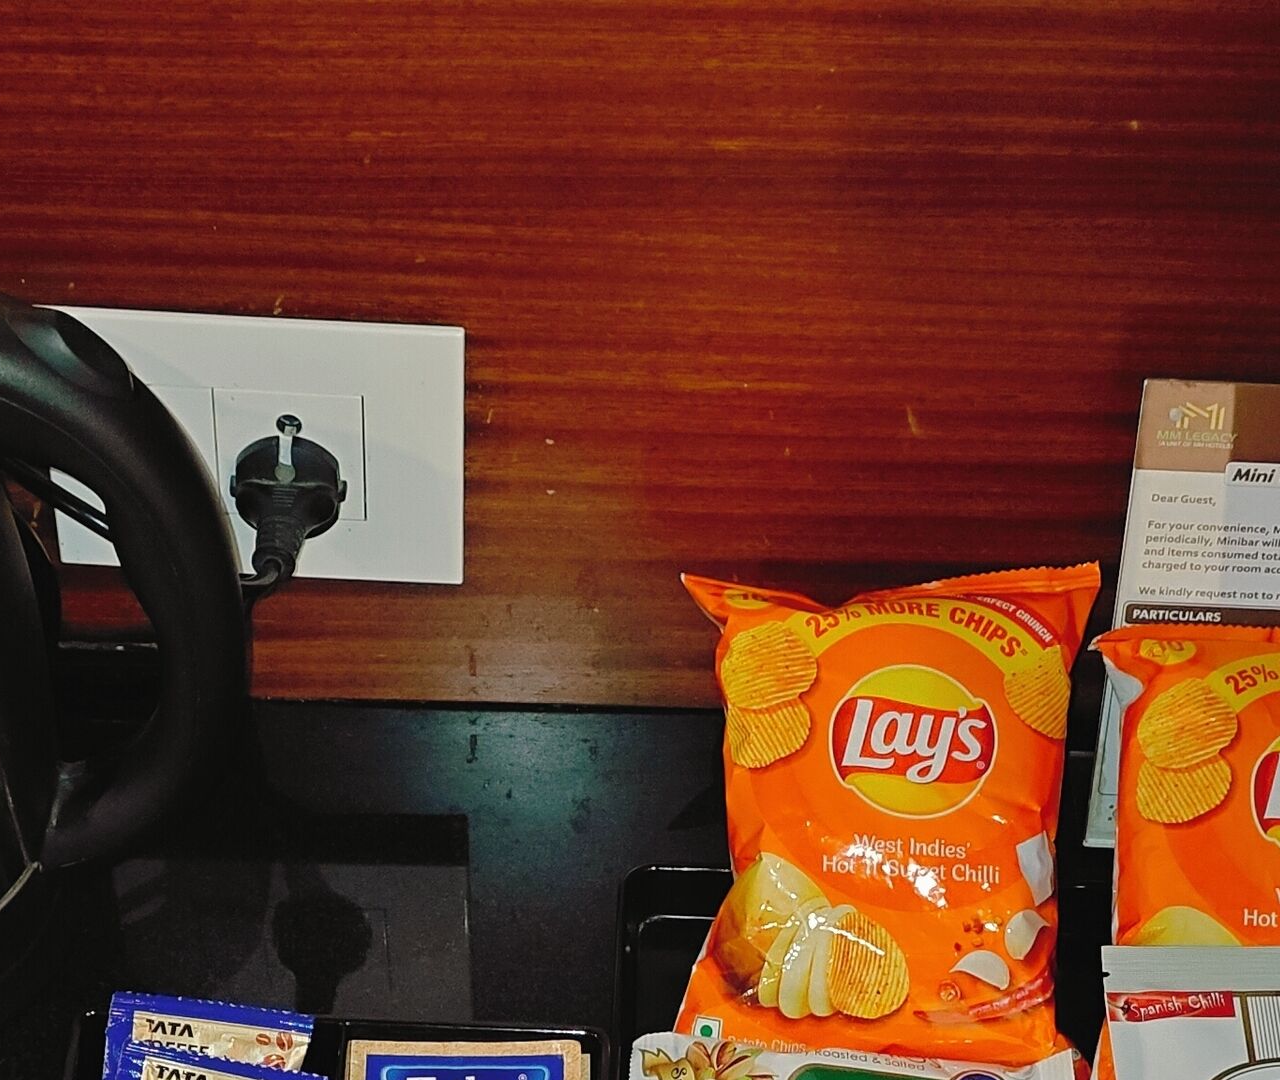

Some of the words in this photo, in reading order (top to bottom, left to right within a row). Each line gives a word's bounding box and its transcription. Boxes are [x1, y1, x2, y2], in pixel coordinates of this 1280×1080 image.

[1184, 431, 1238, 443] LEGACY
[1232, 468, 1276, 484] Mini
[1151, 493, 1179, 504] Dear
[1180, 494, 1216, 507] Guest,
[1147, 520, 1166, 530] For
[1168, 523, 1195, 533] your
[1196, 523, 1270, 536] convenience,
[1145, 534, 1213, 547] periodically,
[1216, 537, 1260, 547] Minibar
[1143, 547, 1165, 557] and
[1167, 548, 1199, 558] items
[1201, 549, 1259, 561] consumed
[1142, 560, 1187, 572] charged
[1203, 564, 1230, 574] your
[1231, 566, 1262, 574] room
[1138, 586, 1156, 596] We
[1158, 586, 1193, 599] kindly
[1195, 589, 1237, 600] request
[1239, 591, 1259, 600] not
[864, 600, 941, 618] MORE
[1132, 609, 1221, 622] PARTICULARS
[1225, 663, 1279, 695] 25%
[841, 699, 988, 783] Lay's
[853, 834, 904, 854] West
[909, 838, 971, 859] Indies'
[822, 855, 857, 874] Hot
[951, 864, 1000, 884] Chilli
[1243, 909, 1279, 929] Hot
[1129, 996, 1183, 1021] Spanish
[1187, 993, 1225, 1011] Chilli
[146, 1018, 194, 1038] TATA
